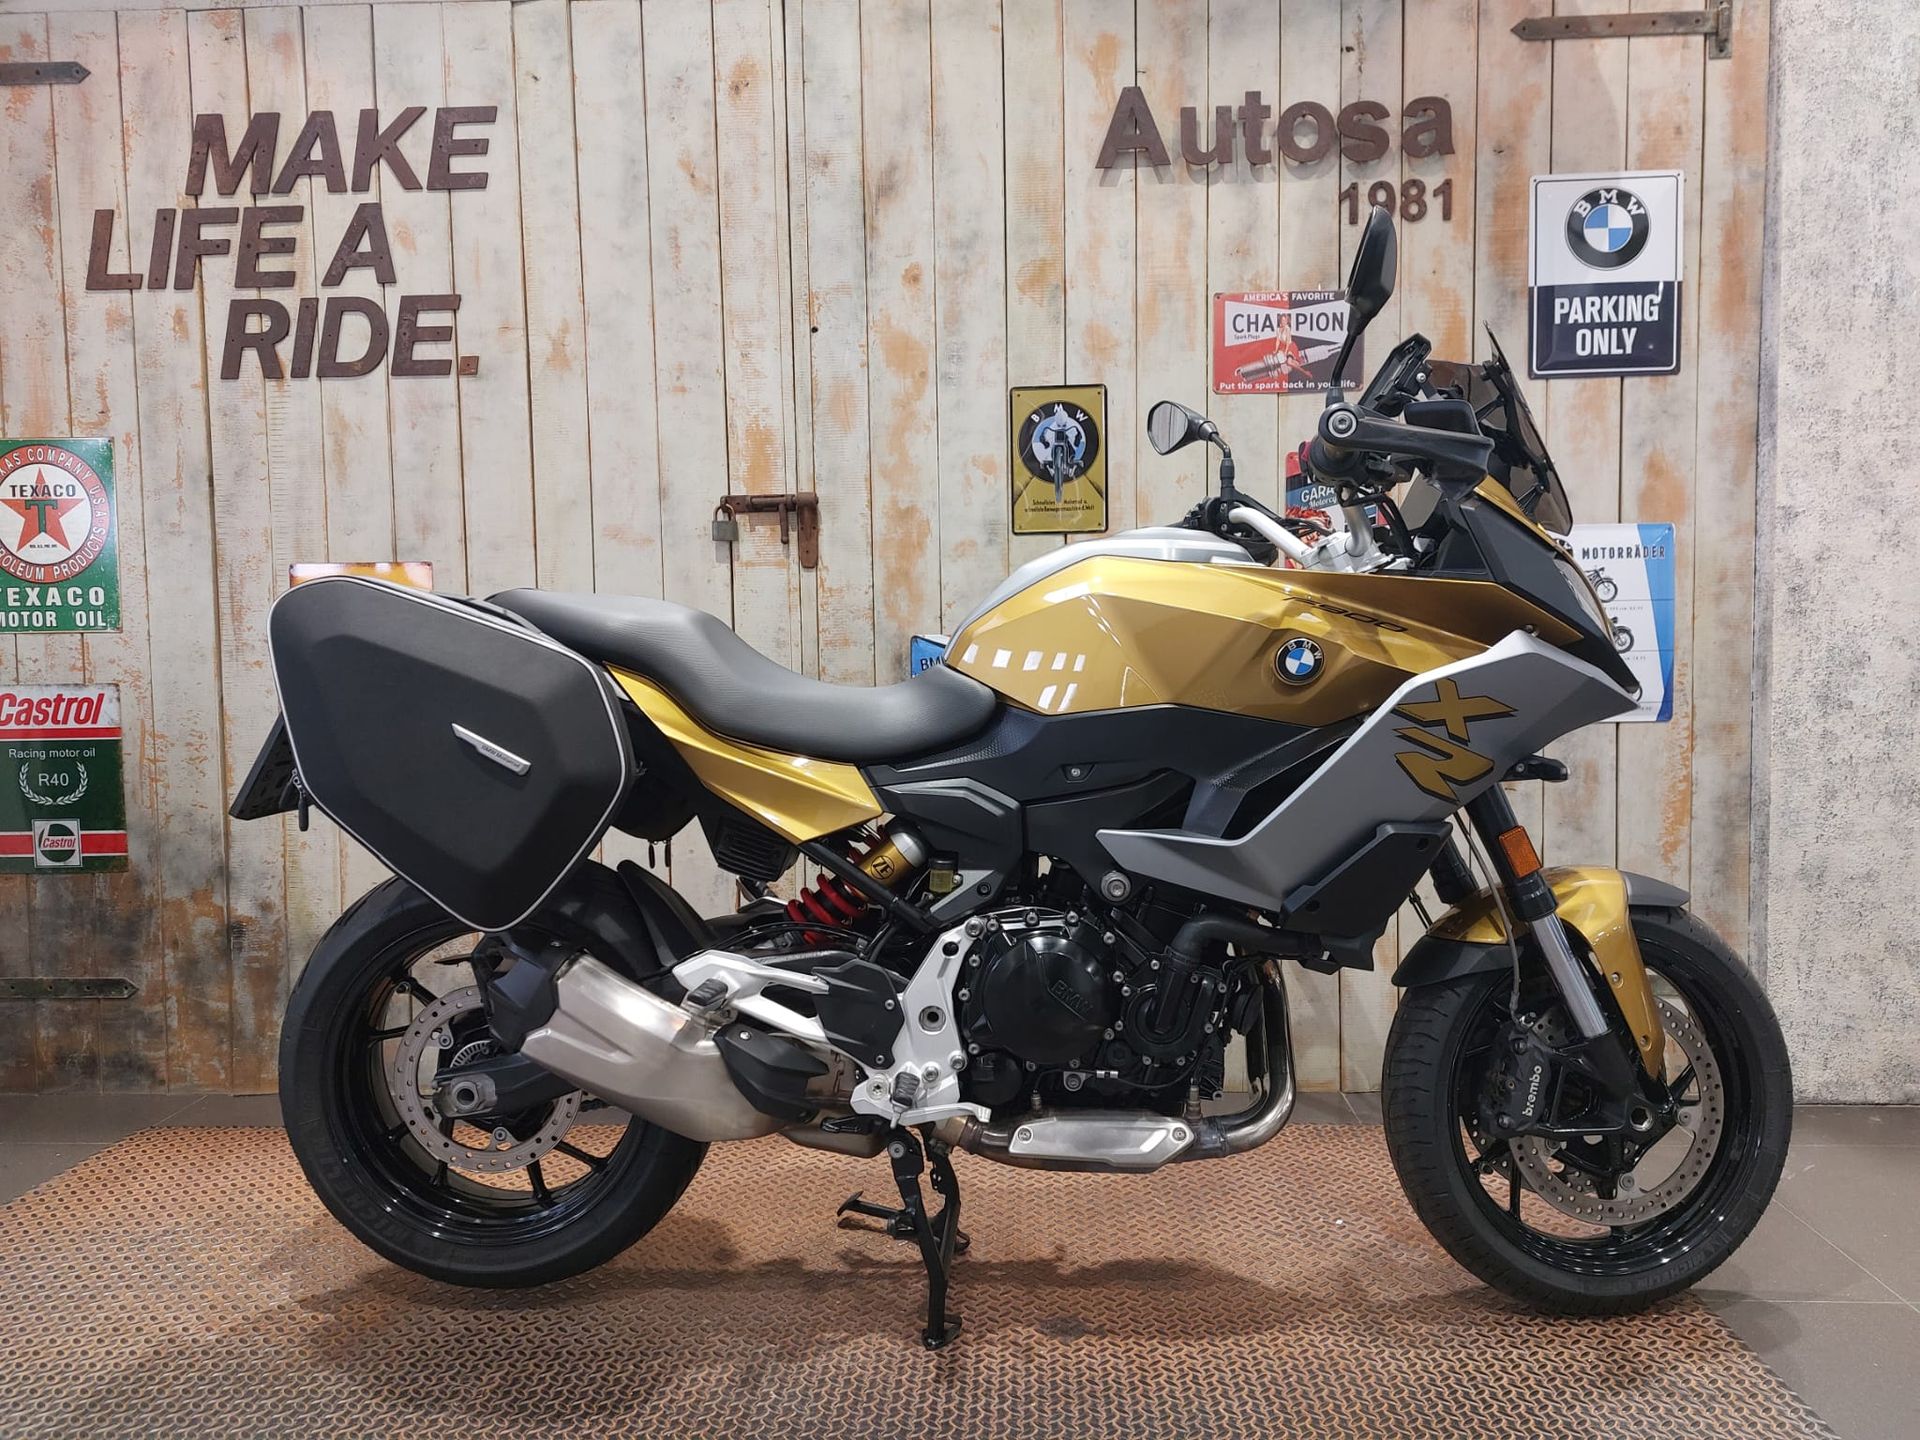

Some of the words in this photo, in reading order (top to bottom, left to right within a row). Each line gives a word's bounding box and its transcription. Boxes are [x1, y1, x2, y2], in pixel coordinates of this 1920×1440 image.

[1095, 86, 1456, 169] Autosa
[185, 105, 498, 196] MAKE
[1339, 178, 1454, 225] 1981
[1574, 189, 1646, 218] BMW
[85, 204, 304, 291] LIFE
[321, 201, 398, 288] A
[1243, 292, 1289, 302] AMERICA'S
[1292, 292, 1335, 301] FAVORITE
[1554, 294, 1660, 325] PARKING
[220, 294, 480, 381] RIDE.
[1576, 327, 1638, 357] ONLY
[1219, 381, 1235, 390] Put
[1237, 381, 1253, 390] the
[1255, 381, 1280, 391] spark
[1283, 380, 1304, 389] back
[1306, 380, 1316, 389] in
[1340, 379, 1356, 389] life
[1031, 403, 1089, 422] BMW
[27, 448, 92, 480] COMPANY
[9, 484, 76, 498] TEXACO
[53, 526, 106, 579] PRODUCTS
[1582, 544, 1665, 560] MOTORRÄDER
[0, 586, 105, 607] EXACO
[75, 610, 107, 627] OIL
[1287, 641, 1323, 660] BMW
[0, 692, 105, 727] Castrol
[9, 748, 46, 760] Racing
[49, 748, 80, 758] motor
[83, 747, 96, 757] oil
[38, 772, 70, 786] R40
[42, 836, 77, 849] Castrol
[1522, 1065, 1542, 1117] brembo
